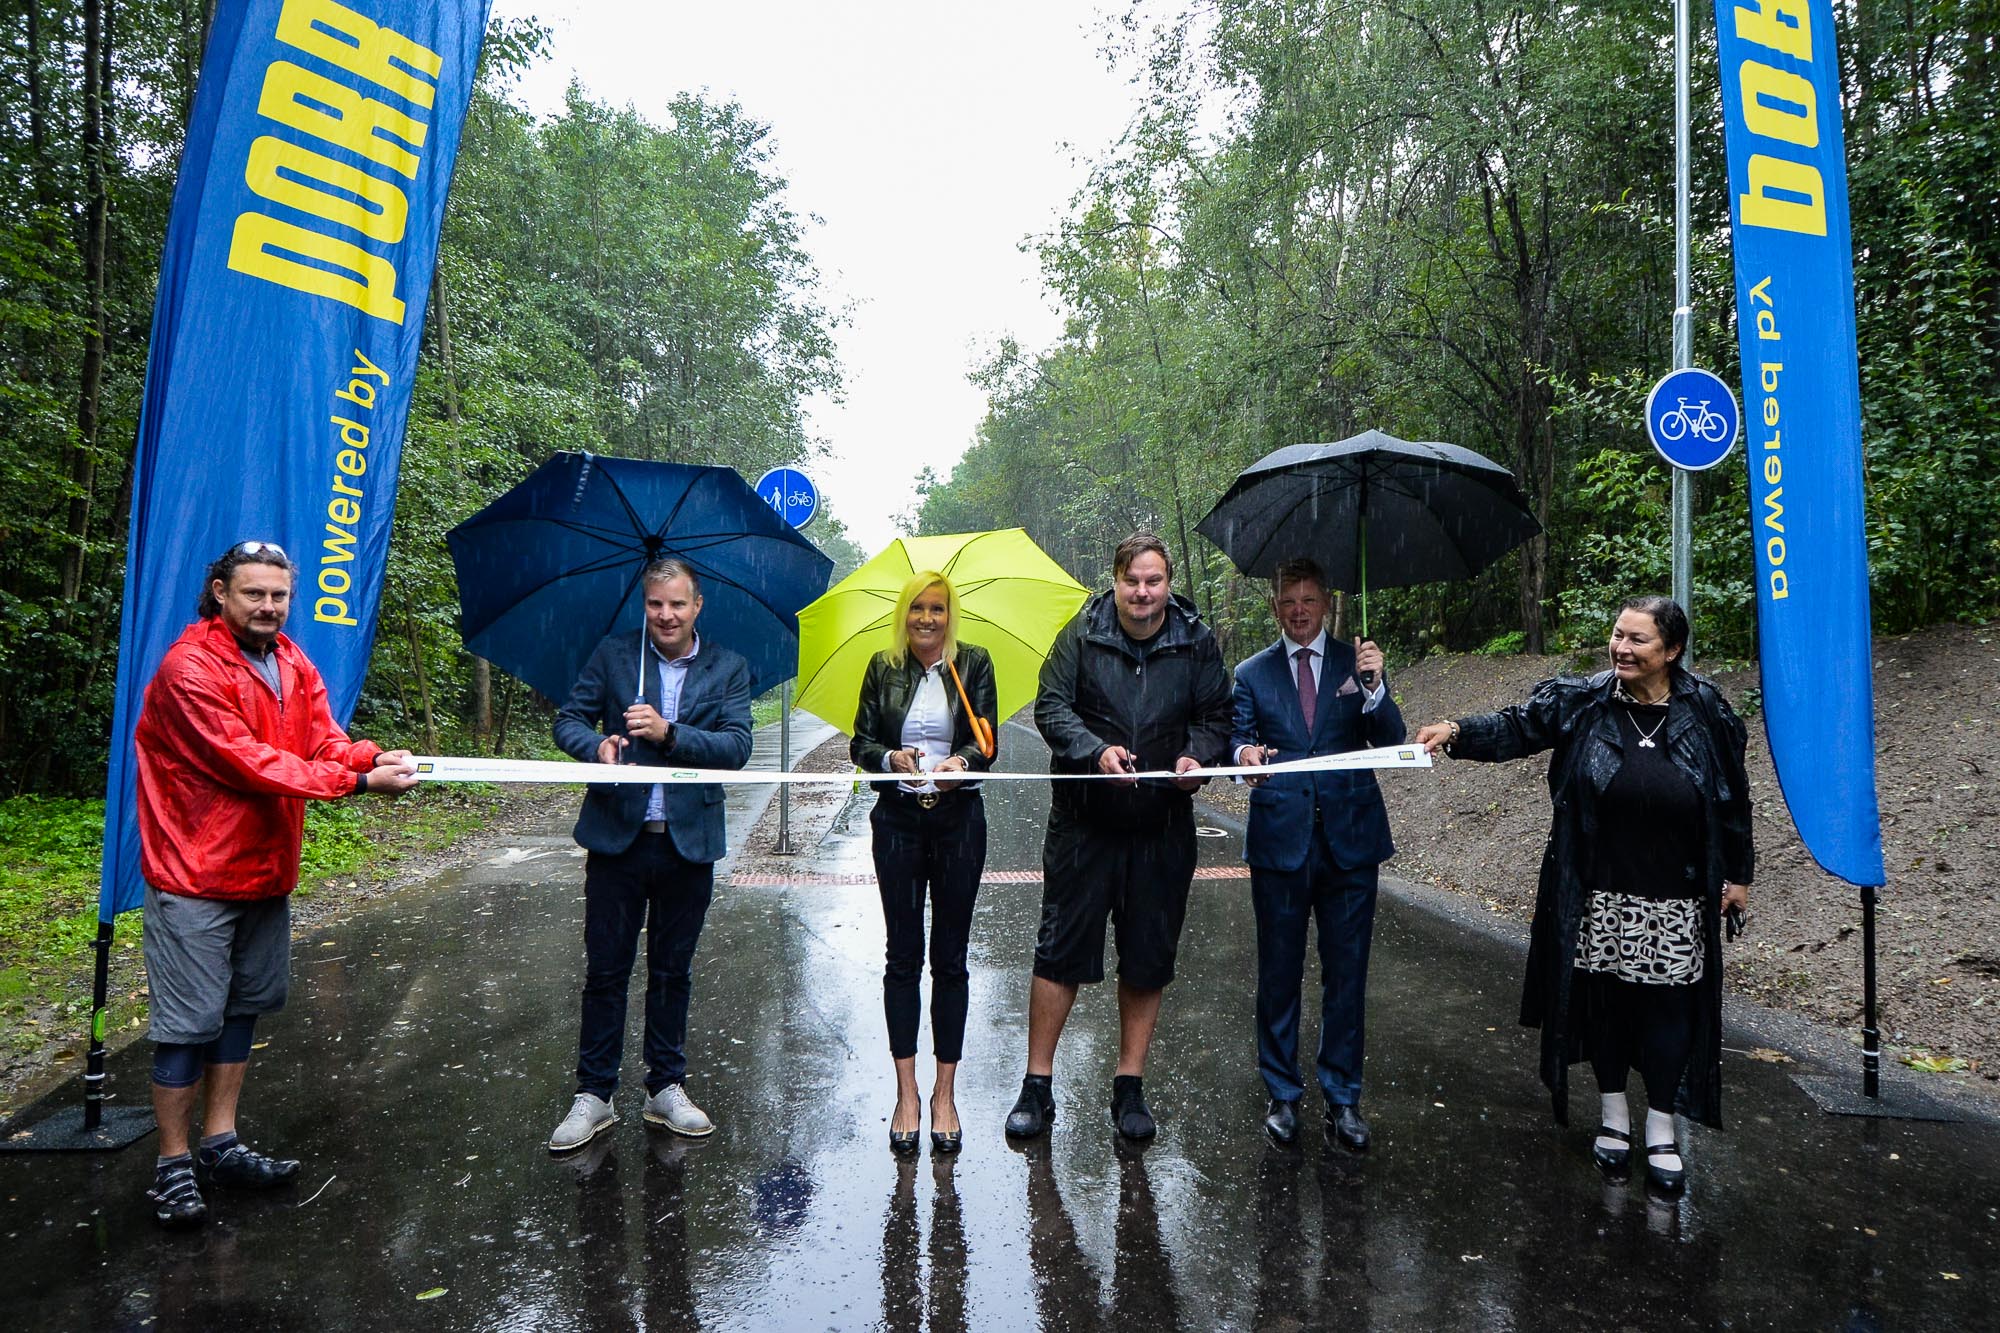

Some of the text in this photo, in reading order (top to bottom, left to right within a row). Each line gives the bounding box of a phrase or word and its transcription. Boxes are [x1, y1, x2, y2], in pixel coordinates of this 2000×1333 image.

[228, 0, 441, 324] PORR
[314, 348, 391, 626] powered by
